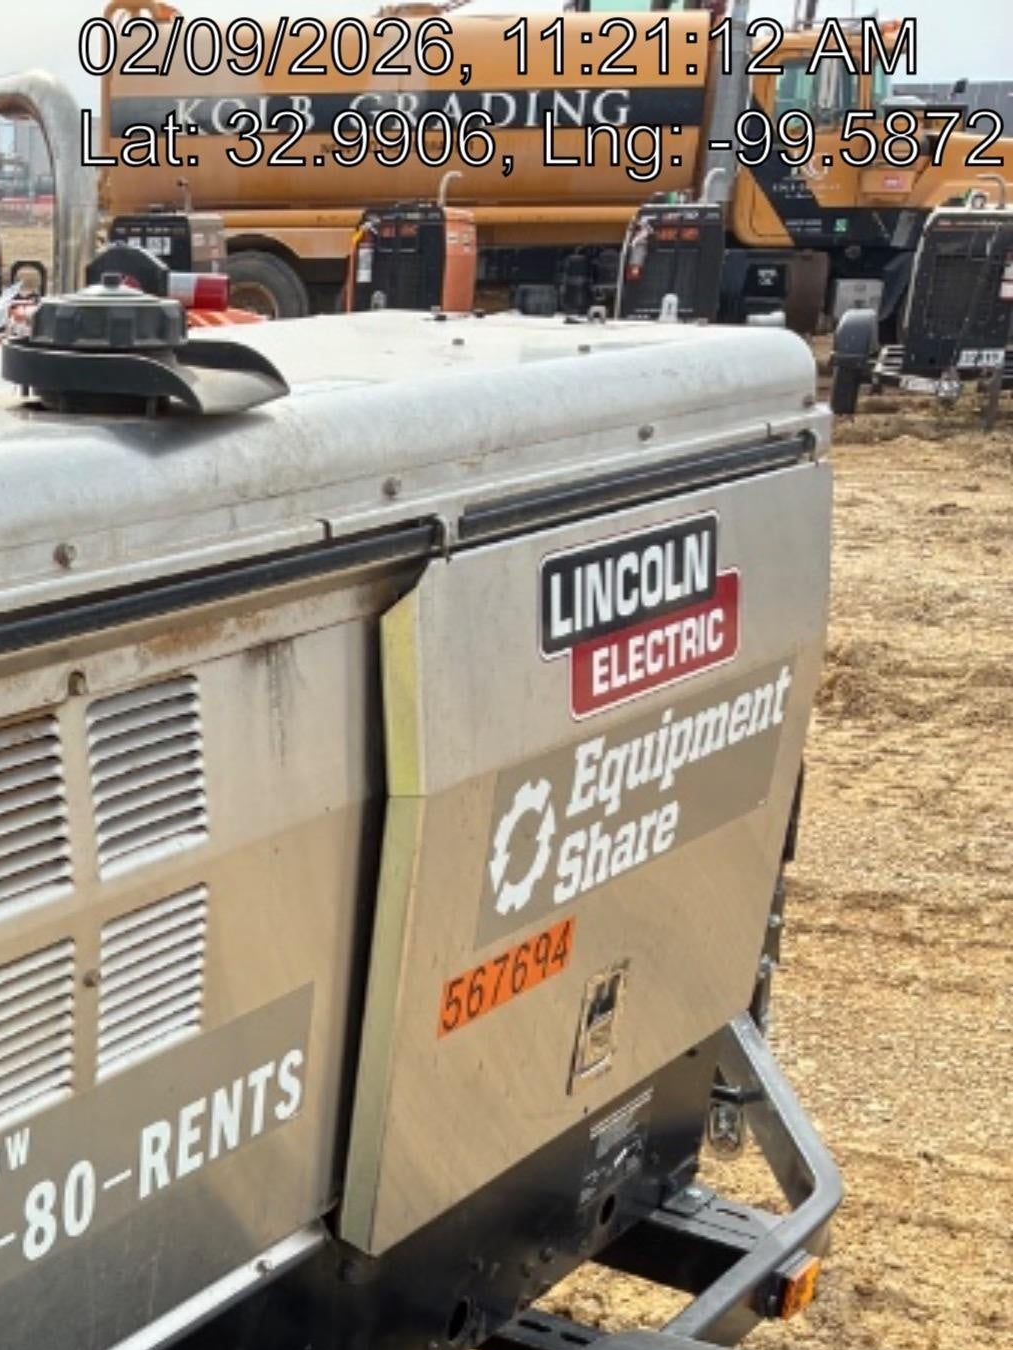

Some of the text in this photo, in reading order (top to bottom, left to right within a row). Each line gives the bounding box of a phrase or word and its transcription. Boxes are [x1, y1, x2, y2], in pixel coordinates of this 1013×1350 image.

[550, 529, 711, 640] LINCOLN
[591, 607, 725, 697] ELECTRIC
[565, 664, 792, 818] Equipment
[553, 800, 680, 905] Share
[442, 920, 572, 1032] 567694
